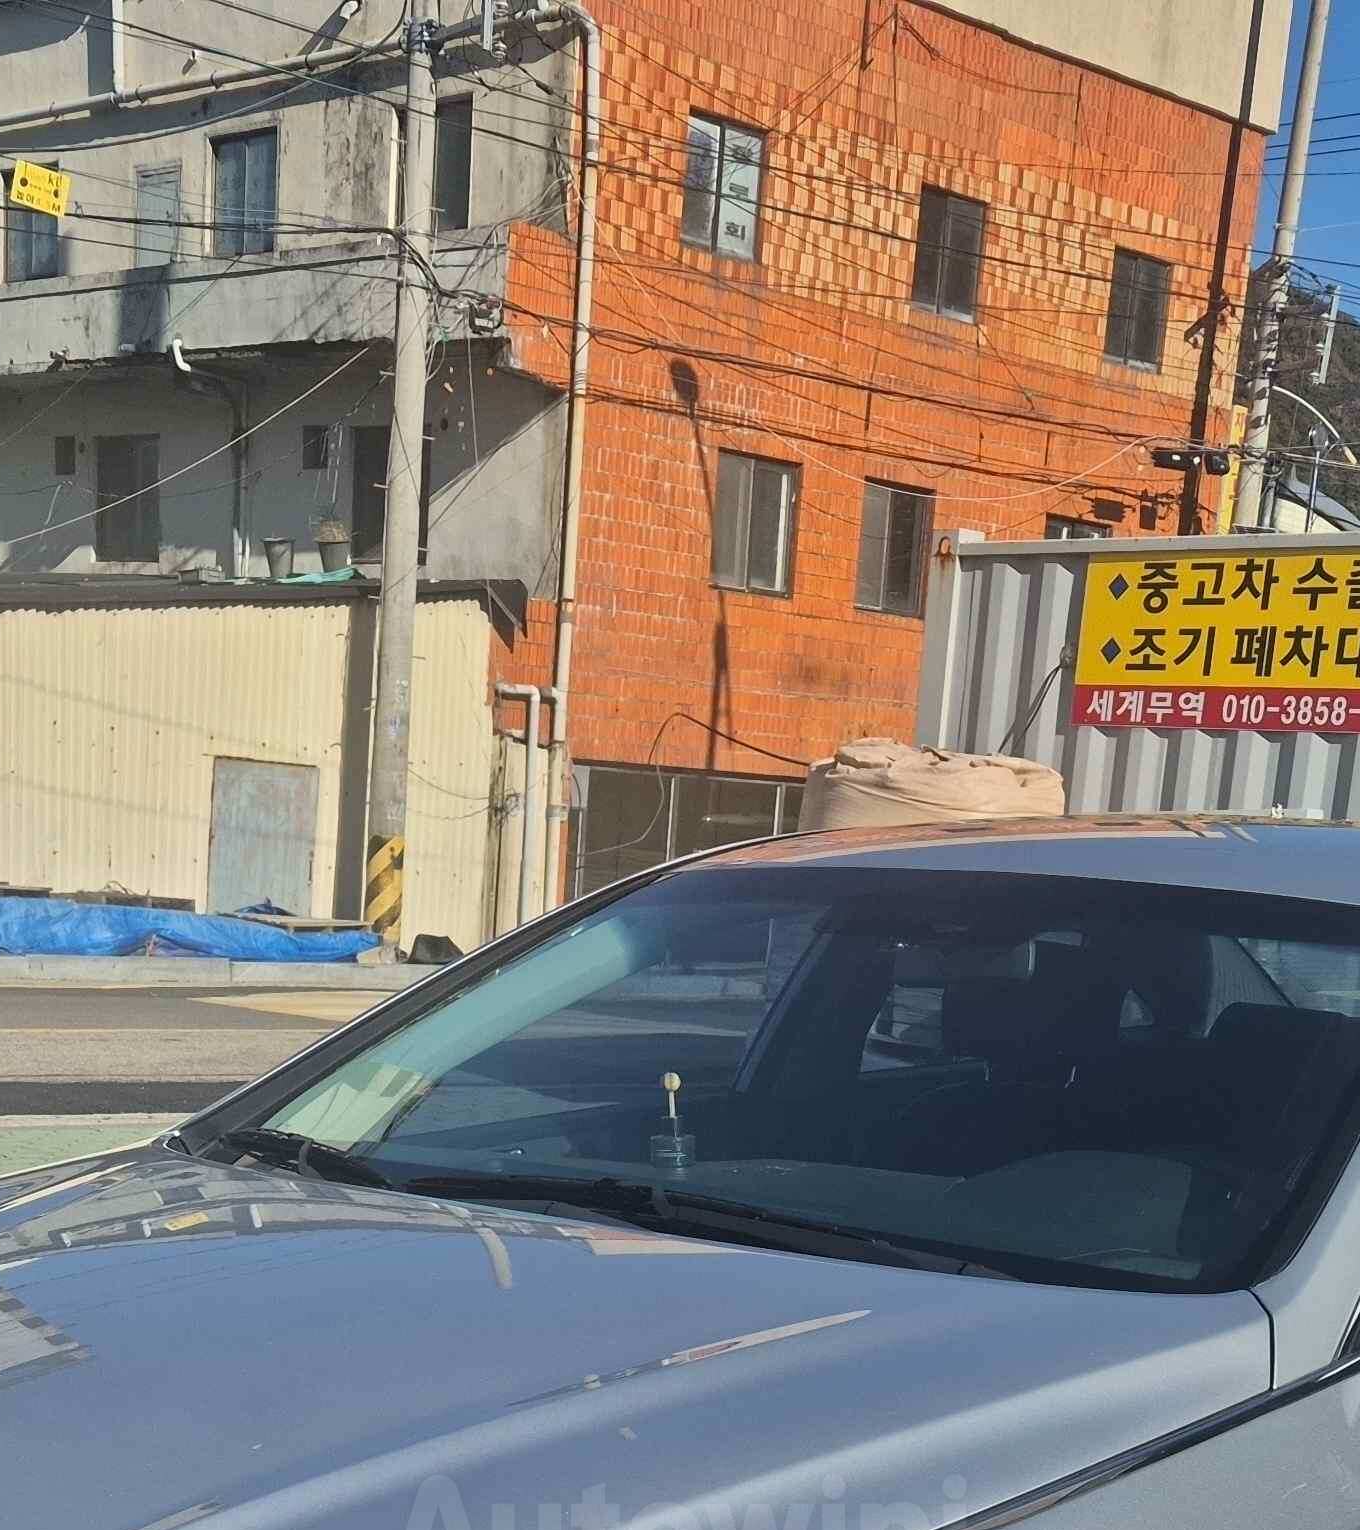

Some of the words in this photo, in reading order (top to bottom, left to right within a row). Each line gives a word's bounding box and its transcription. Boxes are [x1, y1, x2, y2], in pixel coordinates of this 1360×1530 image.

[1137, 556, 1279, 614] 중고차
[1125, 625, 1217, 677] 조기
[1086, 689, 1206, 725] 세계무역
